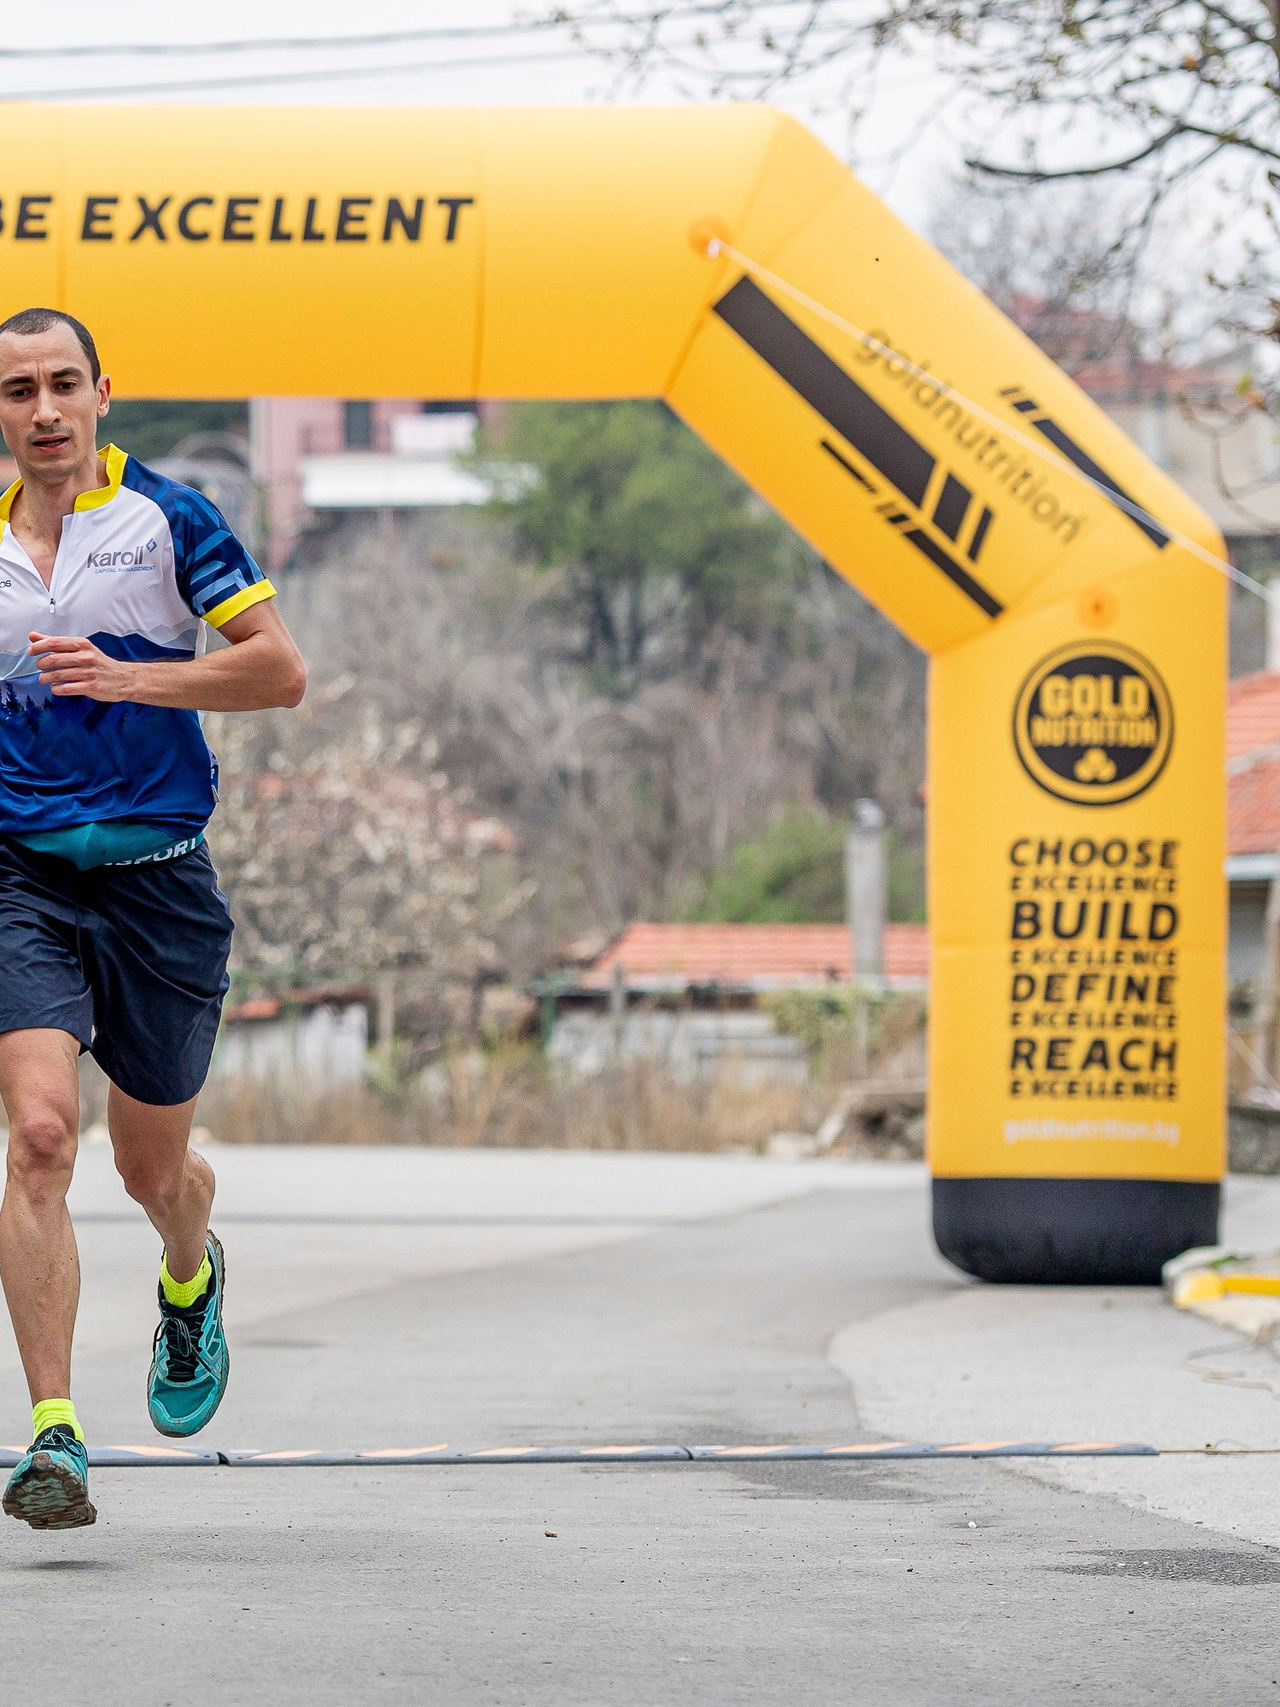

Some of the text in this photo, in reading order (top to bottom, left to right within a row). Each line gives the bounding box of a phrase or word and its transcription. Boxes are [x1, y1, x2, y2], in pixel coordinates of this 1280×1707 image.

[80, 196, 474, 242] EXCELLENT
[853, 329, 1087, 545] goldnutrition
[86, 546, 144, 569] karoll
[1039, 674, 1150, 718] GOLD
[1029, 714, 1157, 748] NUTRITION
[1009, 837, 1180, 869] CHOOSE
[1010, 900, 1180, 941] BUILD
[1010, 973, 1179, 1005] DEFINE
[1009, 1037, 1179, 1072] REACH
